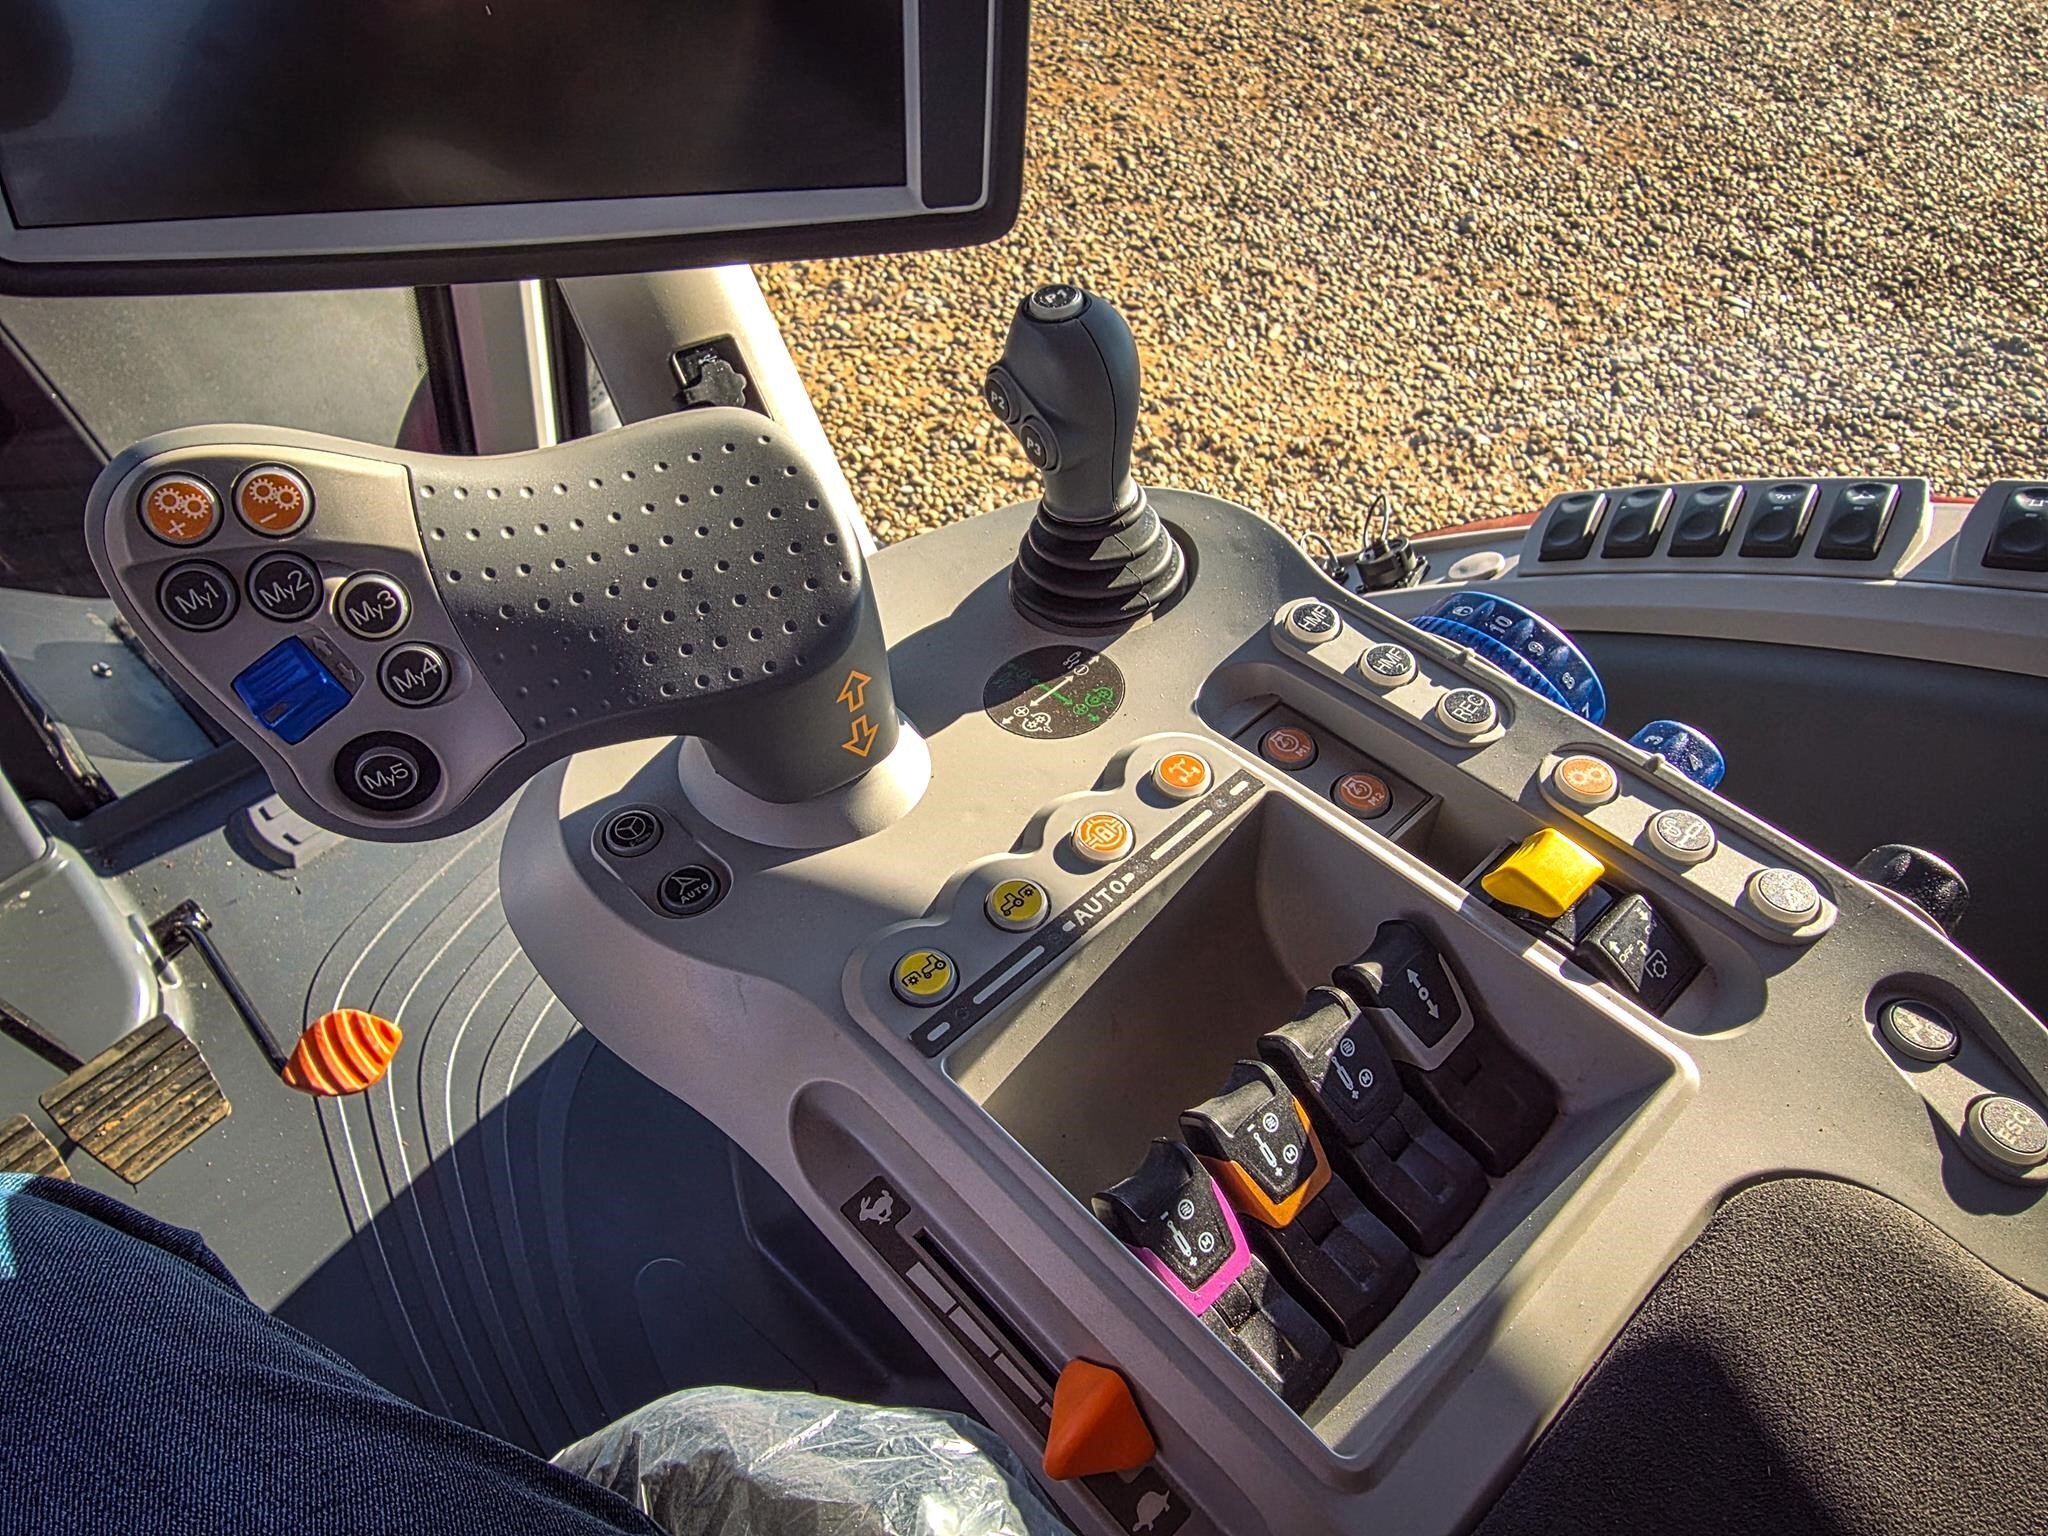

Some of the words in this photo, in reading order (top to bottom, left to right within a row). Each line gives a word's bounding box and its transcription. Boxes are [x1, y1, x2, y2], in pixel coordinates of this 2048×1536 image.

[990, 390, 1005, 410] P2
[1026, 437, 1041, 456] P3
[174, 580, 219, 615] My1
[259, 570, 310, 607] My2
[349, 590, 397, 626] My3
[1298, 605, 1329, 632] HMF
[1489, 615, 1513, 634] 10
[1528, 641, 1545, 656] 9
[1373, 647, 1404, 674] HMF
[1396, 663, 1408, 672] 2
[391, 657, 438, 693] My4
[1562, 671, 1576, 690] 8
[1452, 694, 1484, 722] REC
[1295, 744, 1312, 757] M1
[363, 763, 409, 790] My5
[1368, 792, 1385, 806] M2
[680, 882, 709, 904] AUTO
[1073, 880, 1126, 926] AUTO
[1619, 943, 1635, 963] OFF
